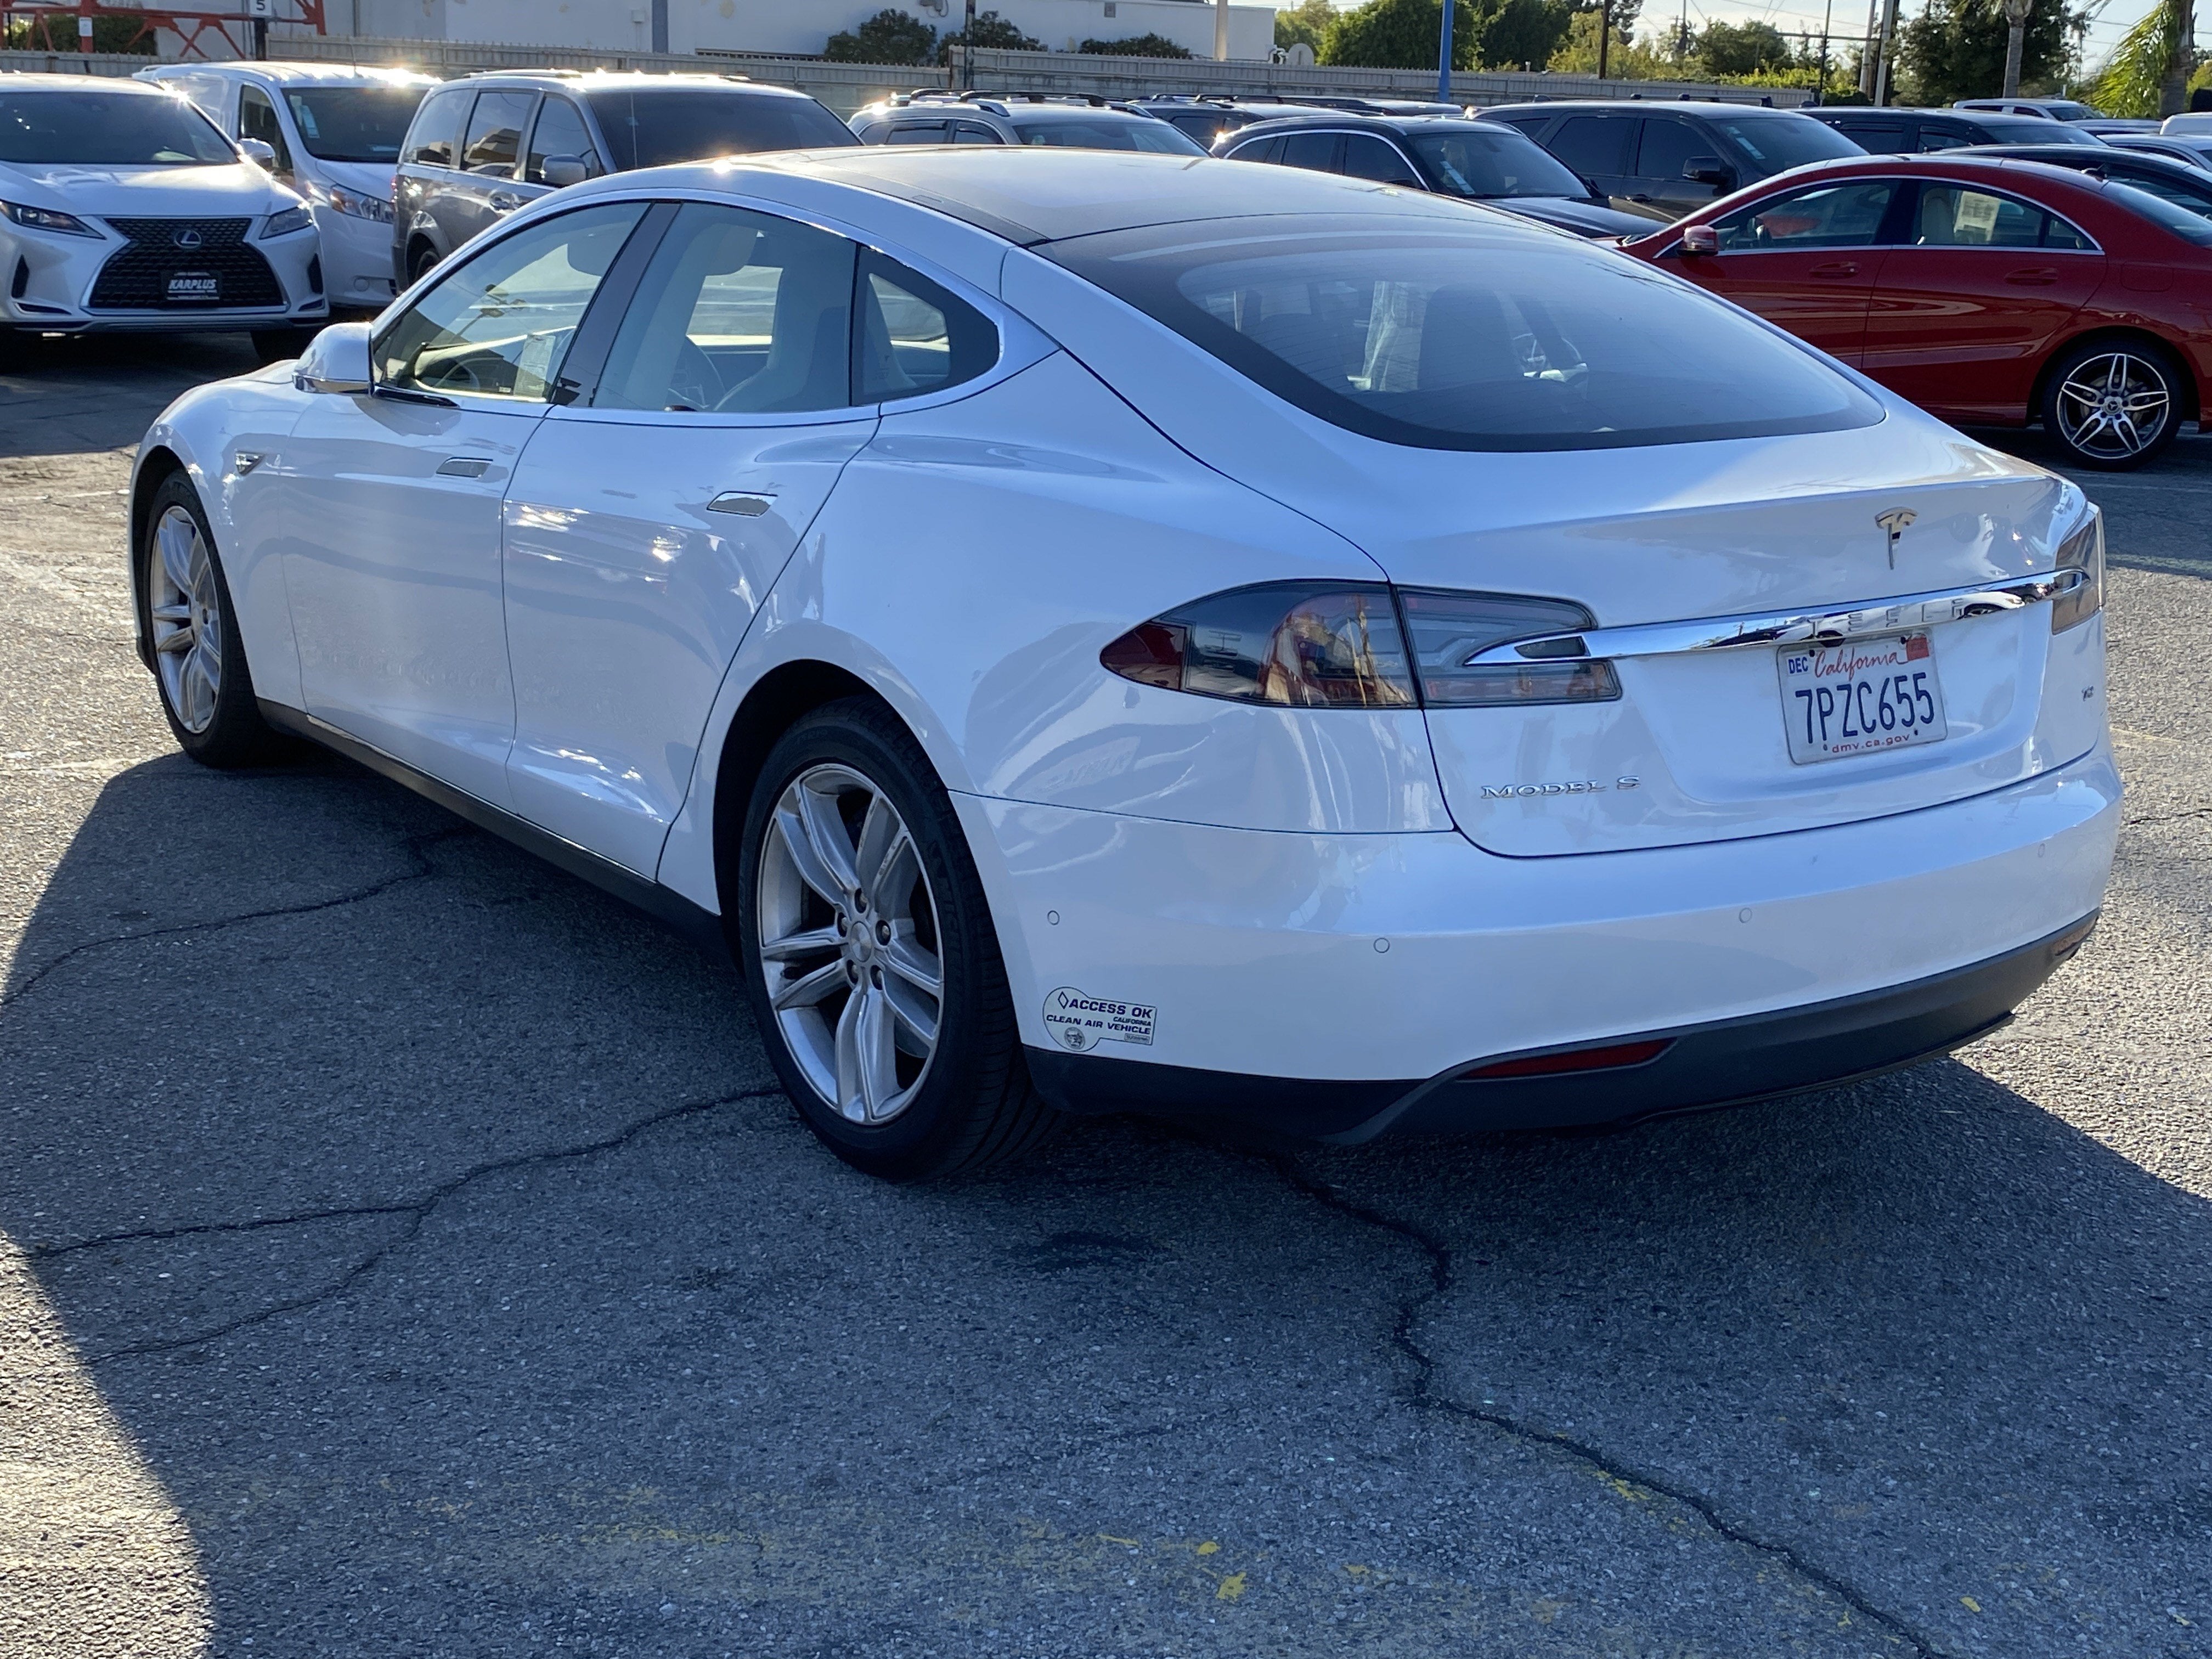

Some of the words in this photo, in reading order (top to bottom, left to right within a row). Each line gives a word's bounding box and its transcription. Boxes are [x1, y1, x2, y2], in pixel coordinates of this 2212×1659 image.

[256, 0, 265, 11] 5
[168, 279, 217, 290] KARPLUS
[1788, 657, 1808, 674] DEC
[1814, 646, 1908, 681] California
[1795, 672, 1934, 744] 7PZC655
[1832, 733, 1911, 754] dmv.ca.gov
[1481, 780, 1607, 799] MODEL
[1617, 775, 1640, 790] S
[1069, 998, 1126, 1015] ACCESS
[1131, 1007, 1153, 1019] OK
[1046, 1014, 1082, 1025] CLEAN
[1085, 1020, 1103, 1028] AIR
[1108, 1022, 1151, 1035] VEHICLE
[1113, 1016, 1152, 1027] CALIFORNIA
